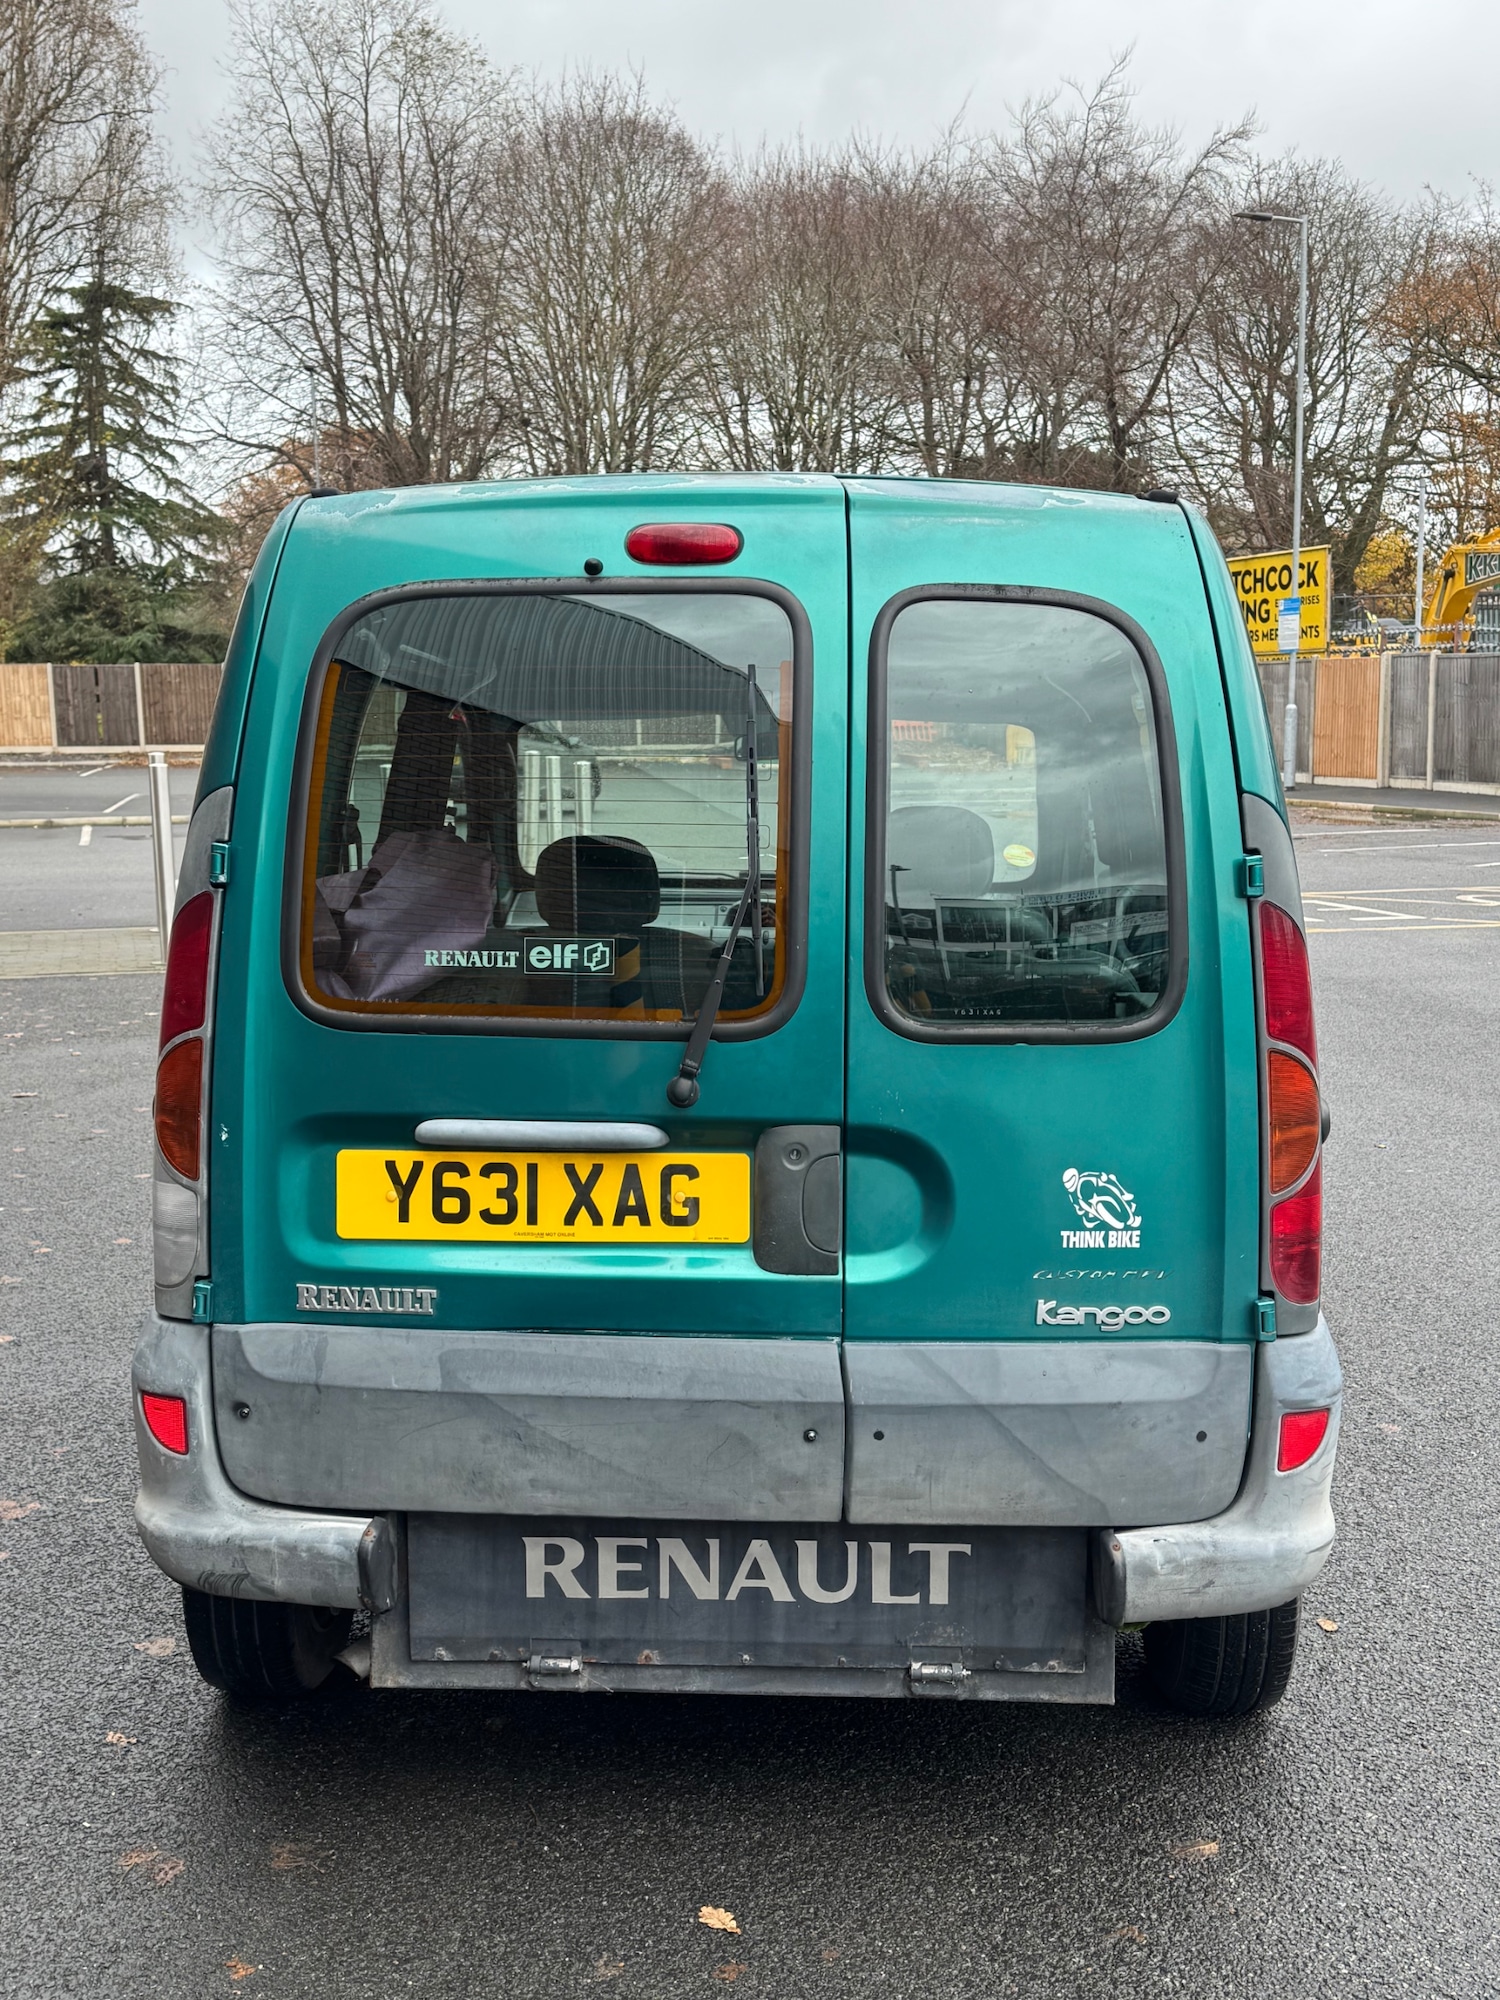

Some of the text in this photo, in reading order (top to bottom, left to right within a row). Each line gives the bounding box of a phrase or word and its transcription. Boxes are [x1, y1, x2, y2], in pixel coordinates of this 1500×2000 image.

[1231, 561, 1319, 595] TCHCOCK
[1261, 625, 1320, 642] MERNTS
[423, 943, 579, 969] RENAULT elf
[384, 1160, 701, 1228] Y631 XAG
[1060, 1230, 1141, 1249] THINK BIKE
[296, 1283, 437, 1315] RENAULT
[1036, 1299, 1171, 1332] Kangoo
[521, 1536, 972, 1605] RENAULT
